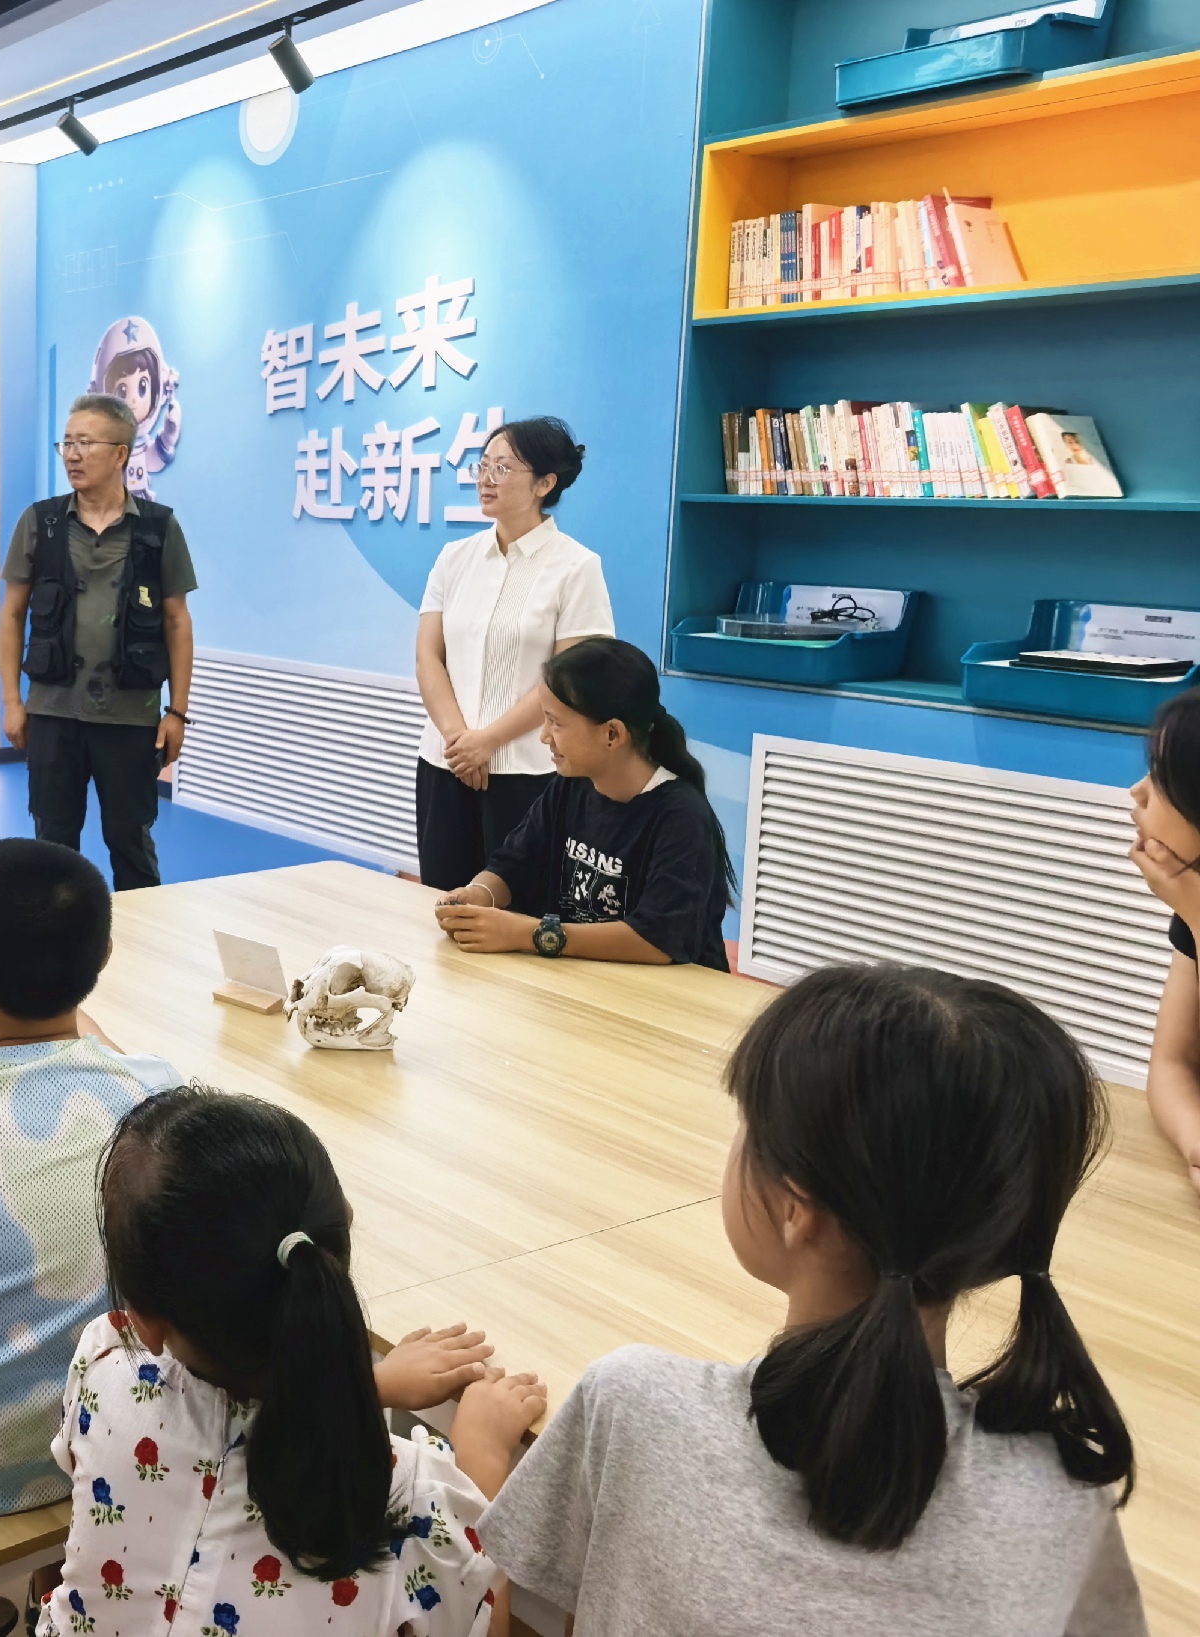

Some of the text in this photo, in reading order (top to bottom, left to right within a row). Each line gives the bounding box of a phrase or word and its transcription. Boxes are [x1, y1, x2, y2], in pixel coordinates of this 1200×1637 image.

[260, 275, 478, 415] 智未来
[565, 836, 624, 874] ISSNG
